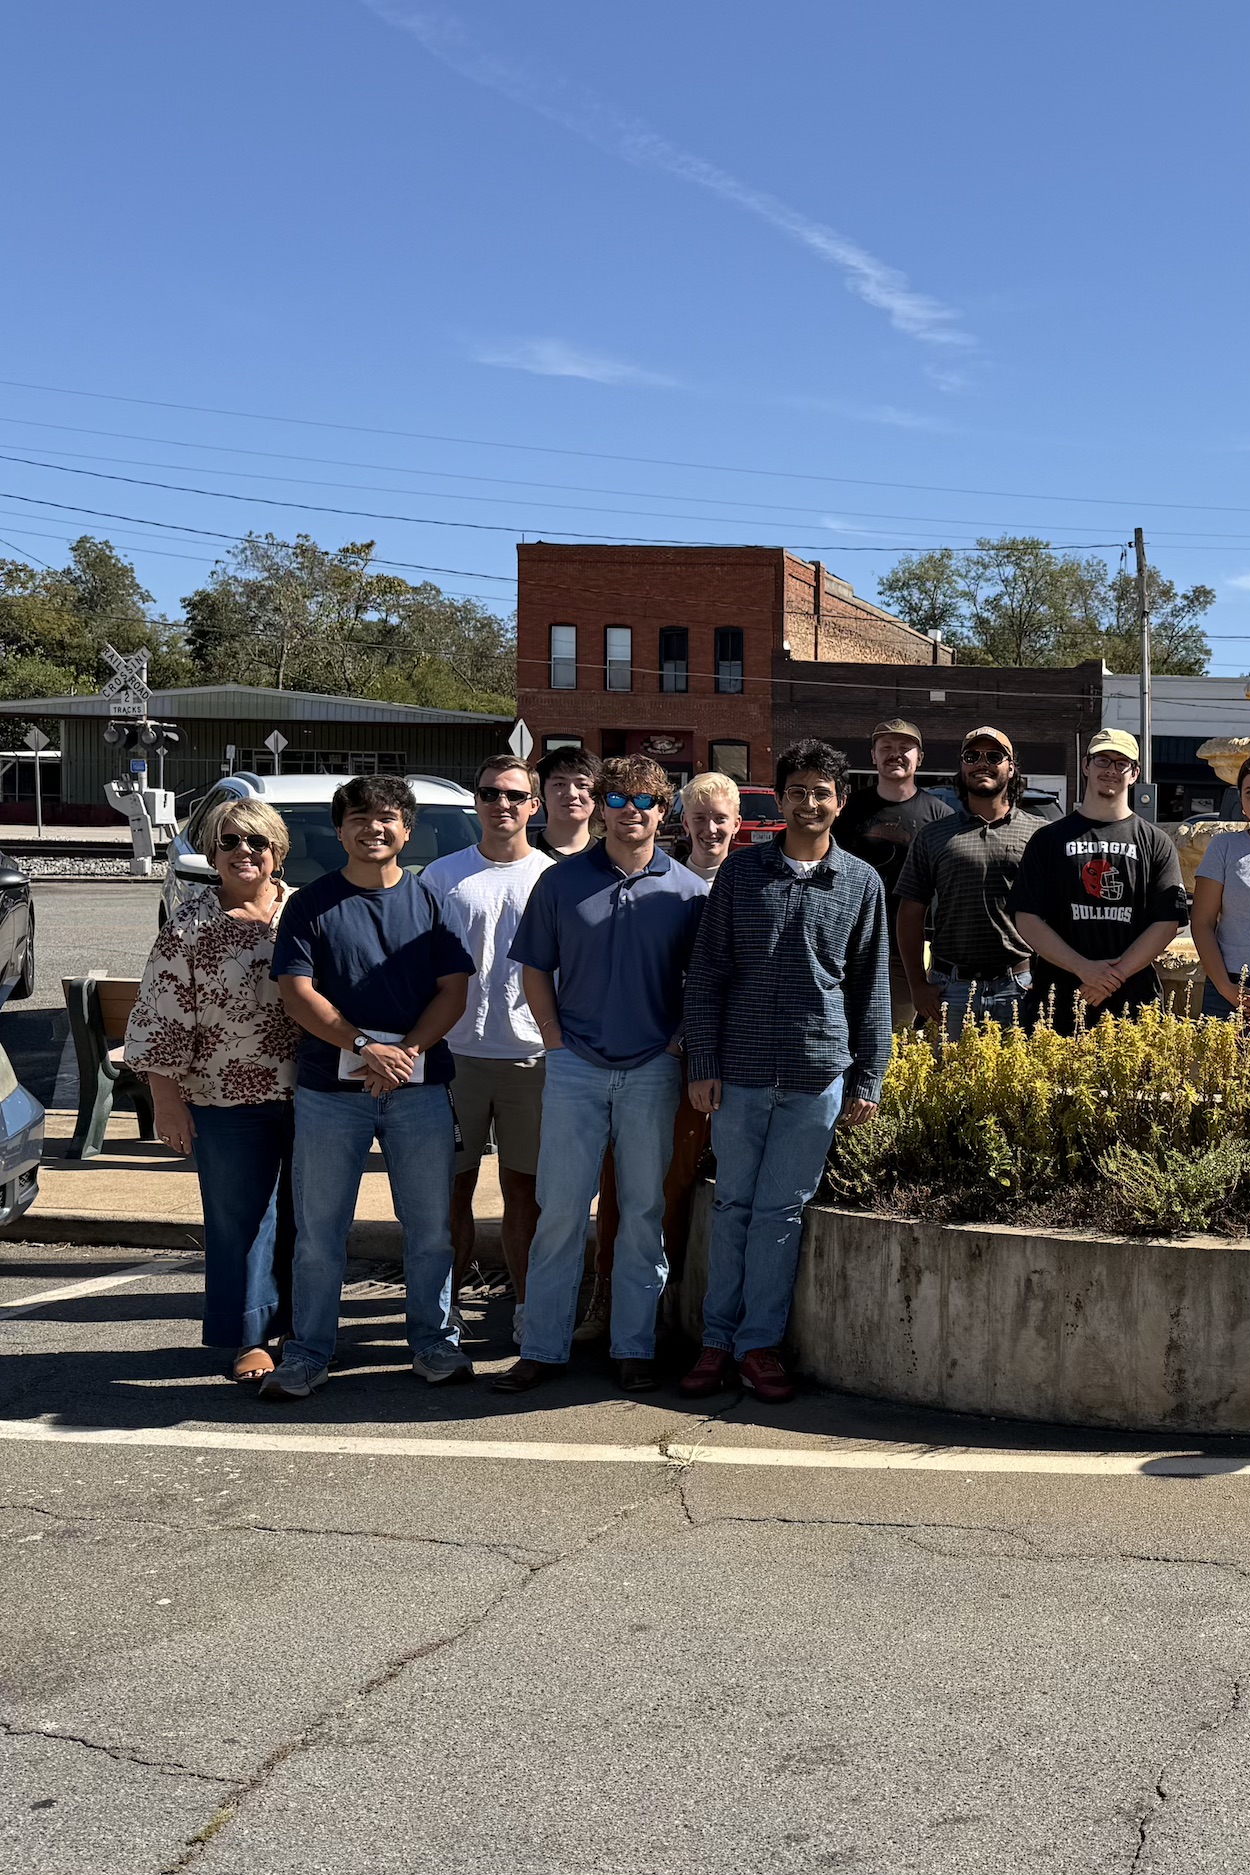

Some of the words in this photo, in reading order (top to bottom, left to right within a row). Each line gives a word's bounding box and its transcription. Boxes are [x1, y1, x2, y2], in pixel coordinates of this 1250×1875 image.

[124, 692, 130, 703] 2
[113, 706, 142, 714] TRACKS
[1065, 840, 1139, 860] GEORGIA
